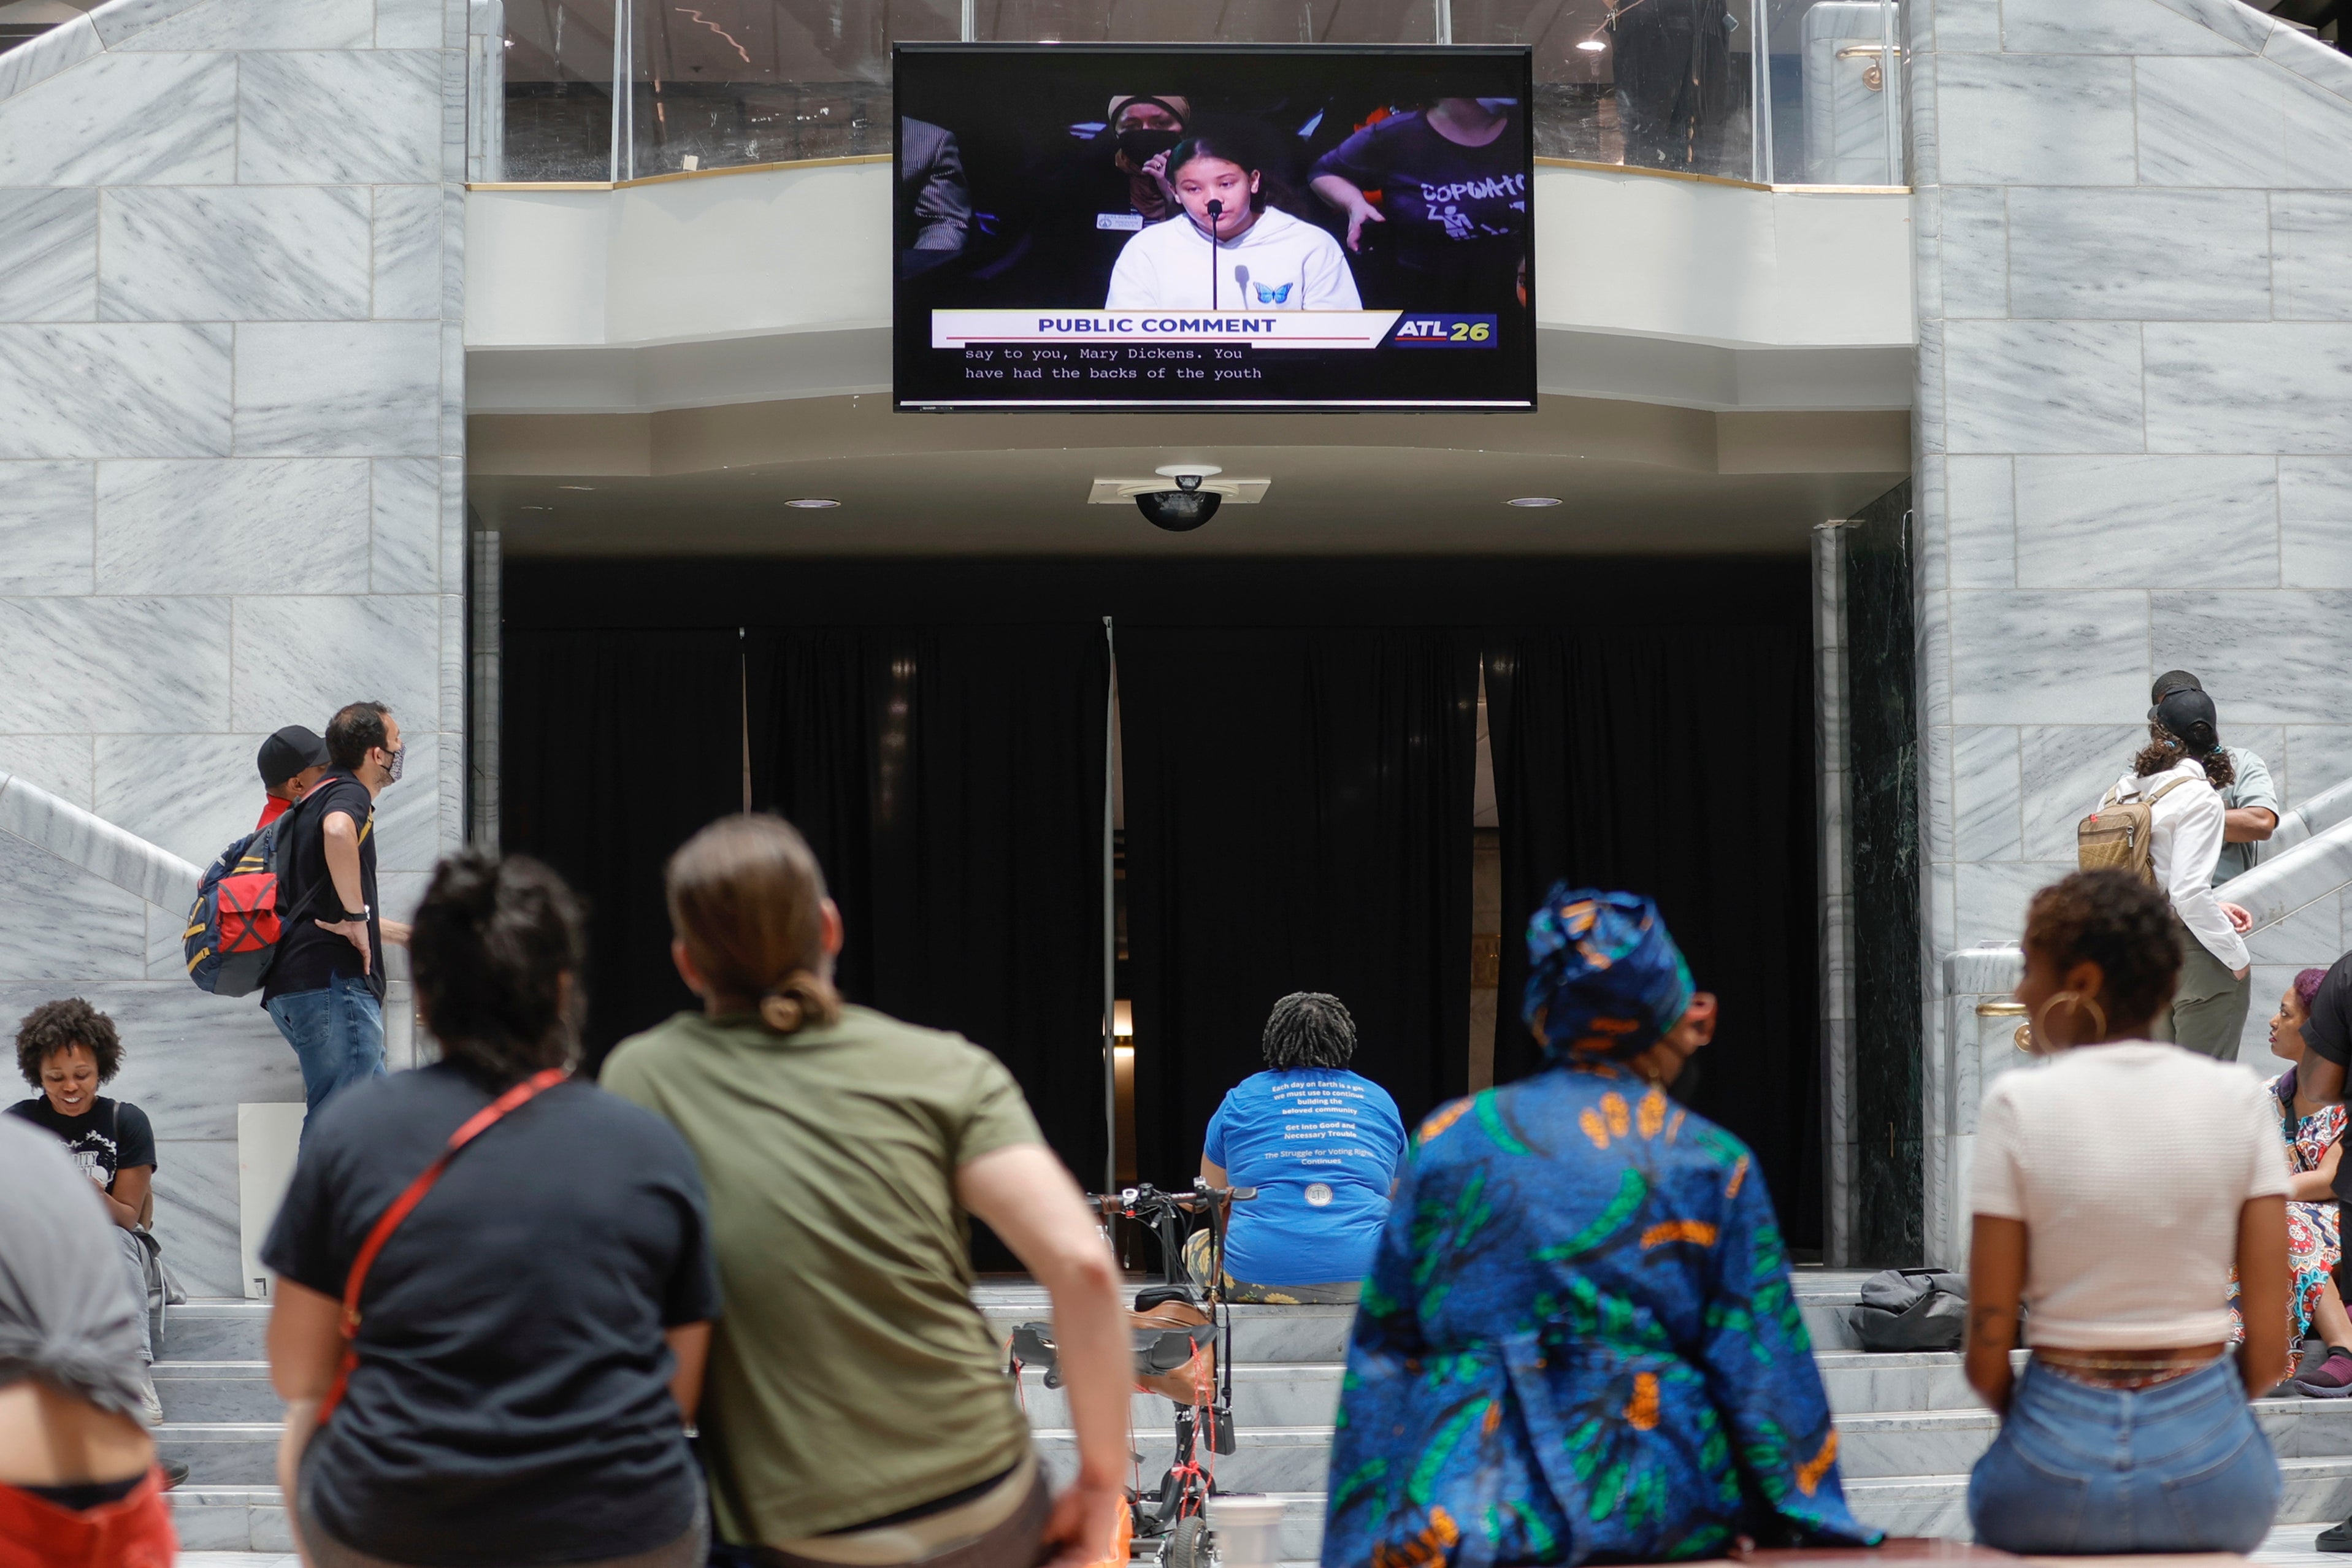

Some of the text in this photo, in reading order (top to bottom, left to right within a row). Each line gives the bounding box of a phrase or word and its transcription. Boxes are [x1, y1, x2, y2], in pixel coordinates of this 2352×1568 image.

[1038, 319, 1276, 332] PUBLIC COMMENT
[1396, 321, 1490, 341] ATL 26
[965, 348, 1243, 361] say to you, Mary Dickens. You
[965, 367, 1262, 381] have had the backs of the youth
[1272, 1084, 1289, 1092] Each
[1331, 1090, 1365, 1099] continue
